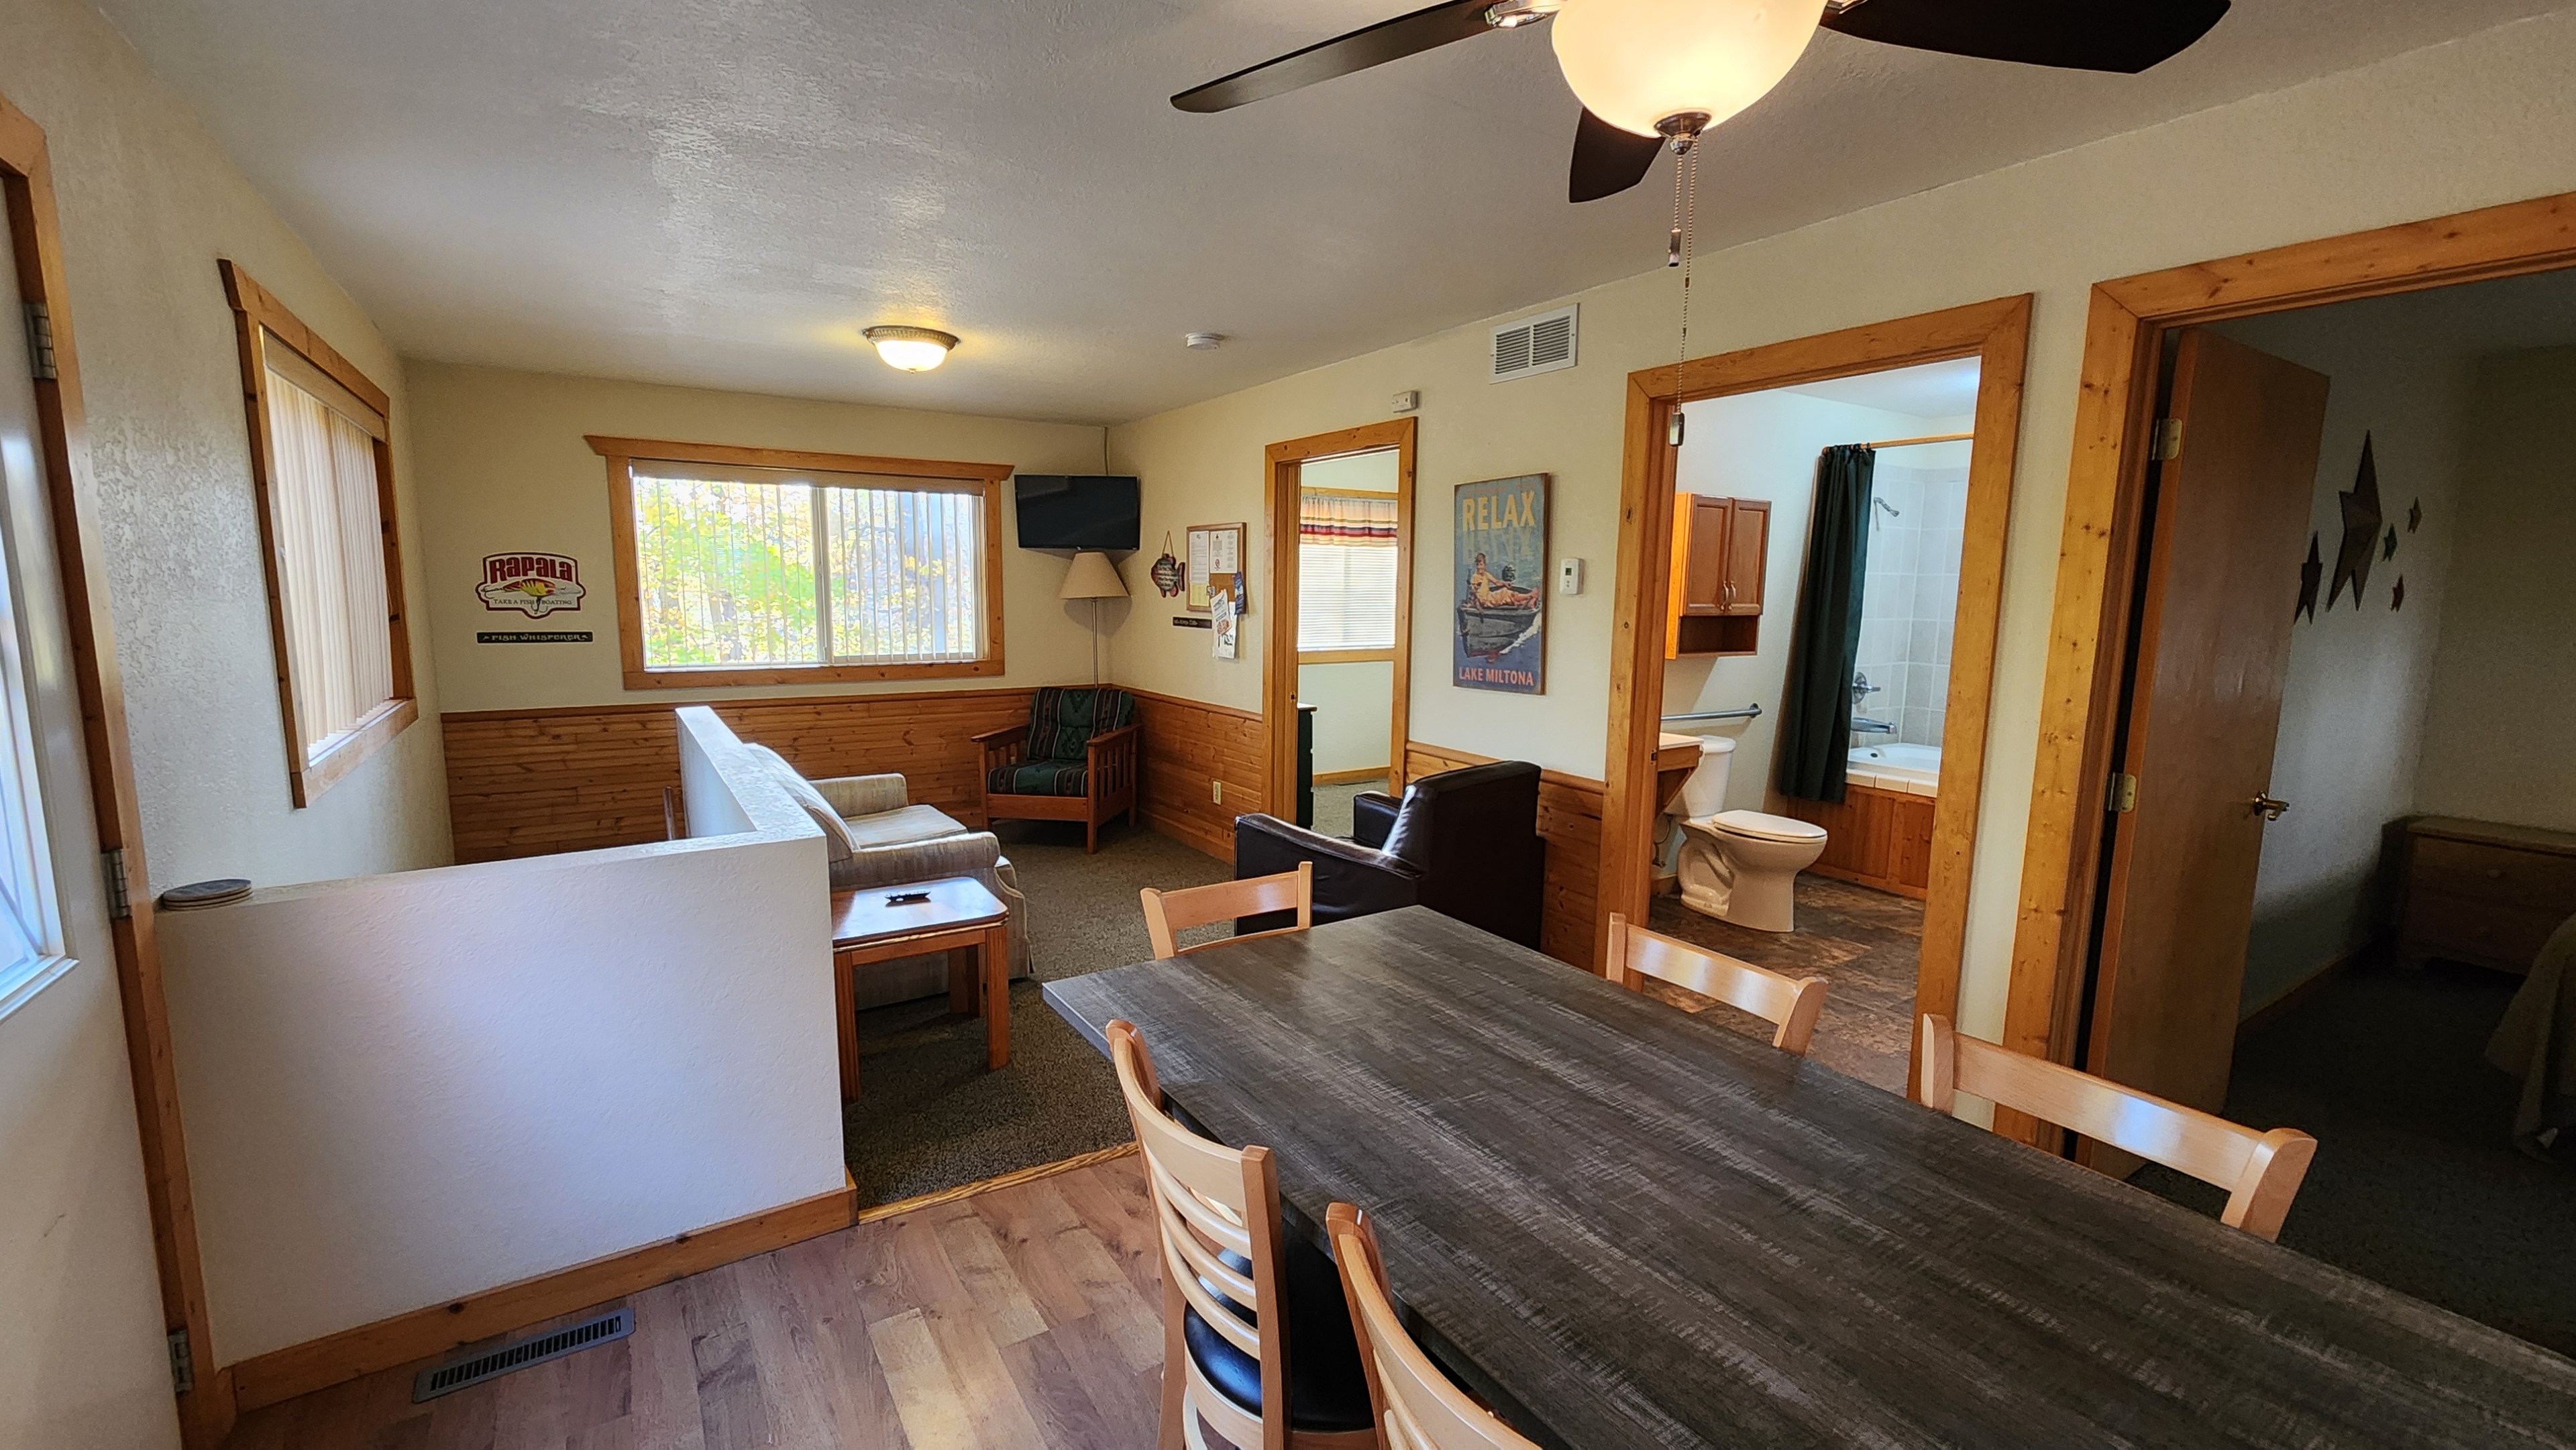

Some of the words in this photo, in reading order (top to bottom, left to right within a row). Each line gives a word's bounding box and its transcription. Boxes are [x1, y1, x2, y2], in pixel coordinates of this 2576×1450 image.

[1462, 490, 1535, 531] RELAX
[519, 633, 582, 641] WHISPERER
[1458, 666, 1484, 681] LAKE
[1486, 668, 1535, 686] MILTONA
